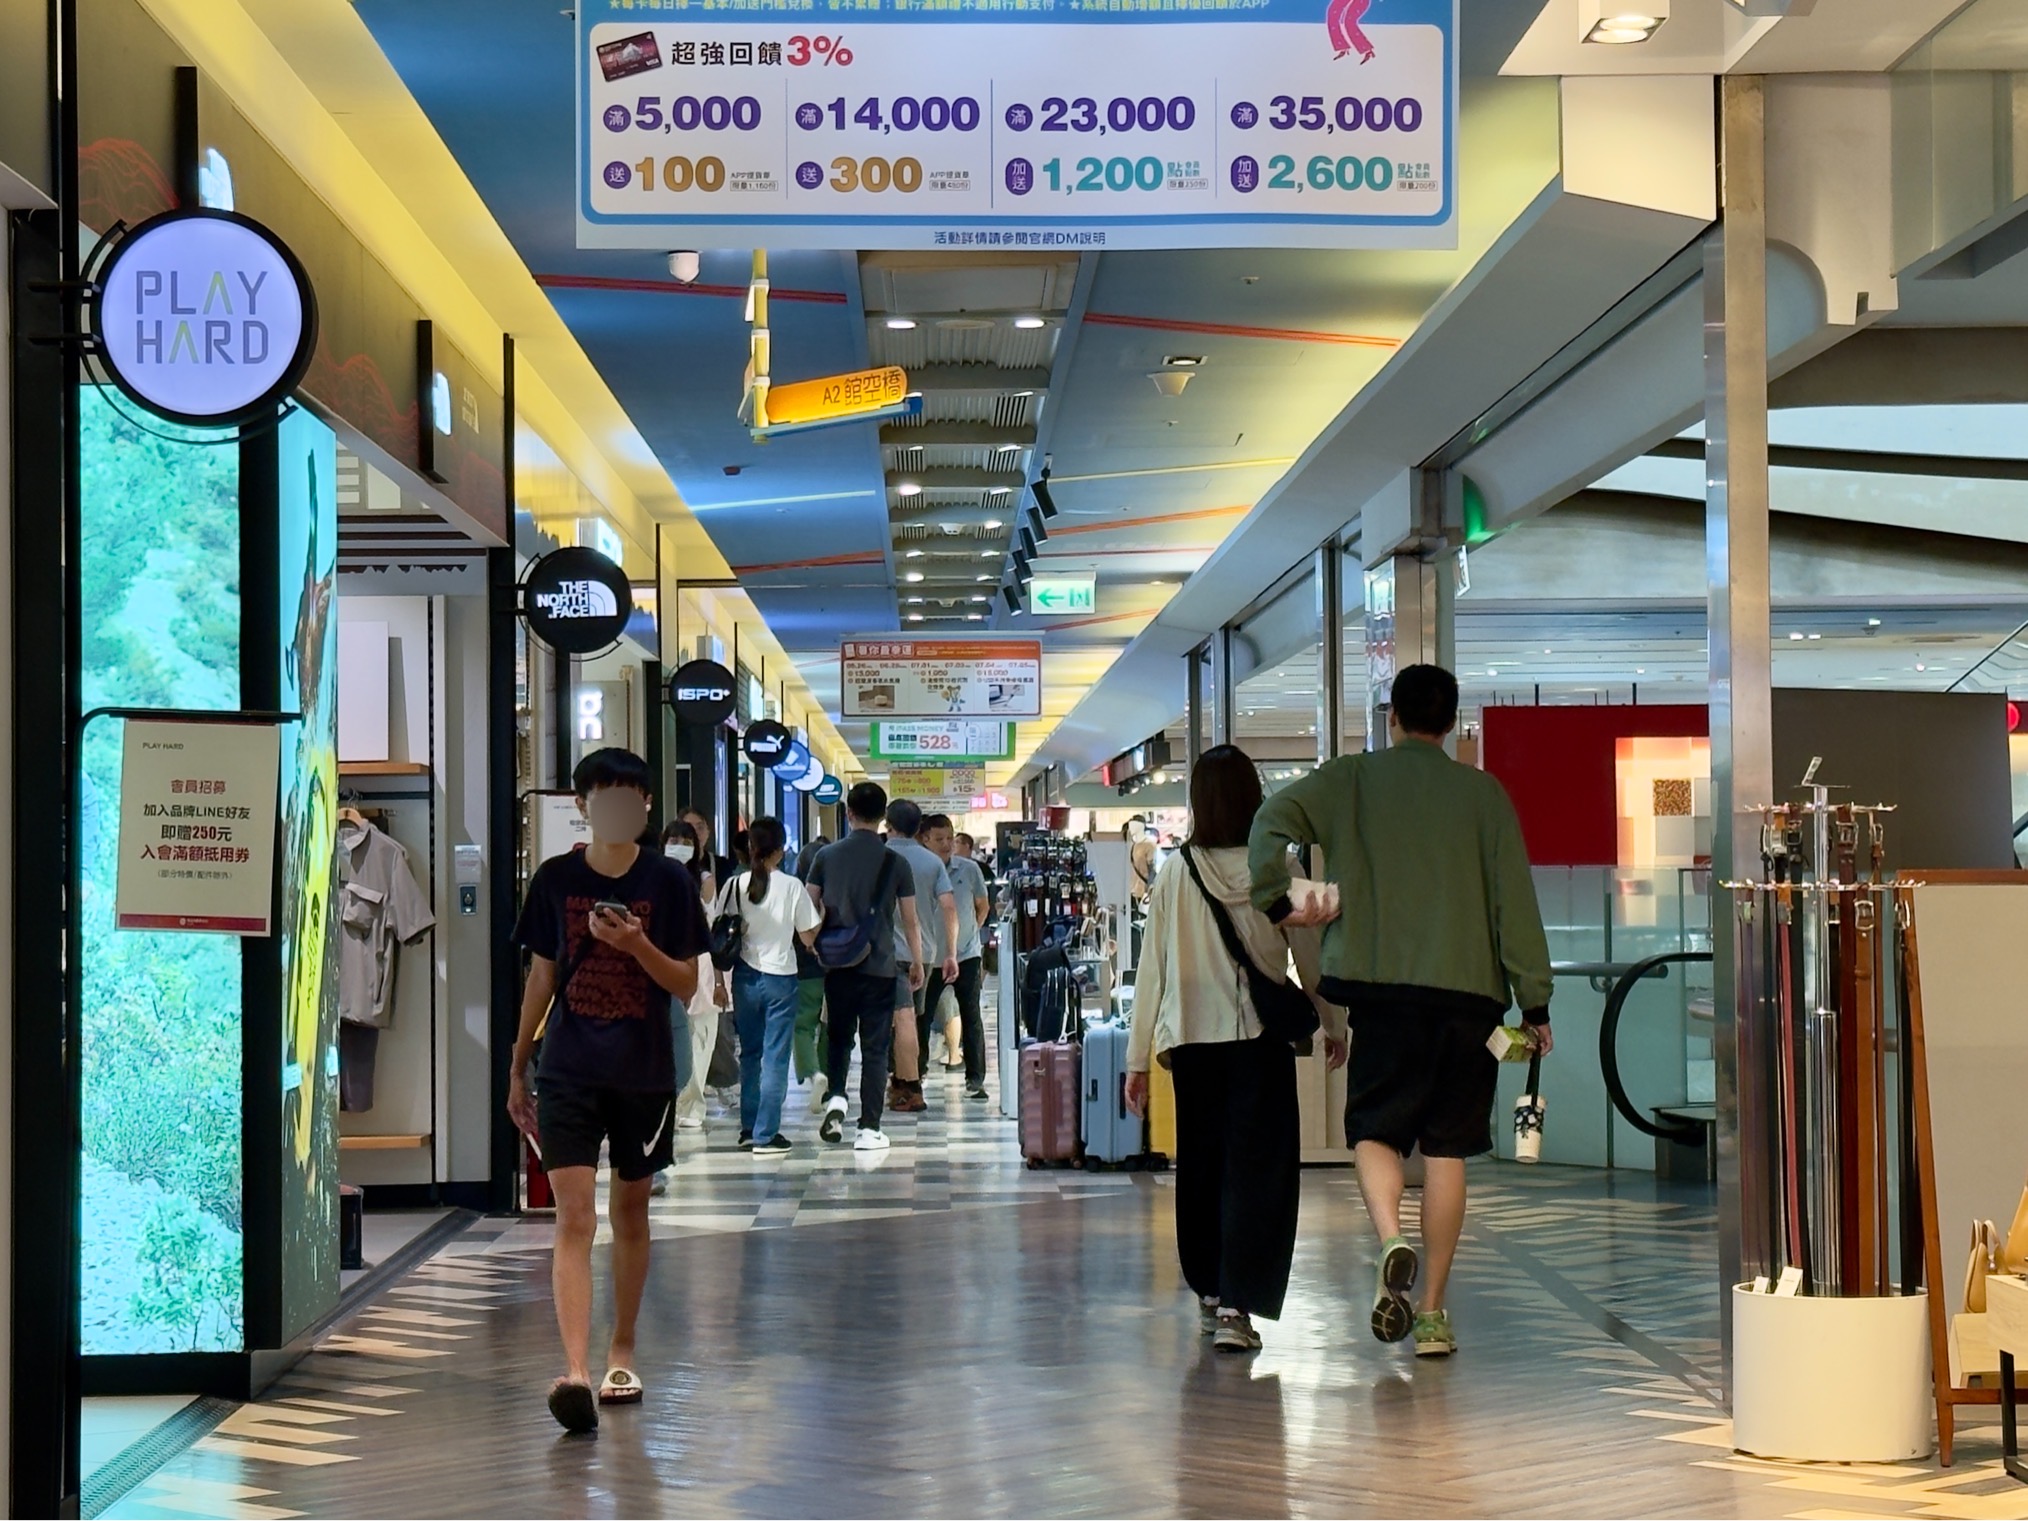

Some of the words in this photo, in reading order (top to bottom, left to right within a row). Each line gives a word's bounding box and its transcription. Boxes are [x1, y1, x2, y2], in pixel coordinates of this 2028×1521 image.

[671, 35, 854, 67] 超強回饋3%
[635, 96, 761, 135] 5,000
[827, 96, 981, 135] 14,000
[1040, 96, 1195, 135] 23,000
[1269, 95, 1423, 134] 35,000
[635, 155, 726, 193] 100
[829, 156, 923, 193] 300
[1011, 161, 1027, 191] 加送
[1042, 156, 1164, 196] 1,200
[1237, 160, 1253, 188] 加送
[1267, 154, 1393, 194] 2,600
[136, 270, 268, 315] PLAY
[136, 320, 269, 364] HARD
[822, 385, 841, 406] A2
[843, 368, 901, 406] 館空橋
[536, 592, 589, 608] NORTH
[558, 580, 589, 594] THE
[552, 605, 589, 618] FACE
[142, 742, 161, 750] PLAY
[170, 779, 227, 795] 會員招募
[143, 803, 250, 820] 加入品牌LINE好友
[160, 824, 233, 842] 即贈250元
[140, 844, 250, 863] 入會滿額抵用券
